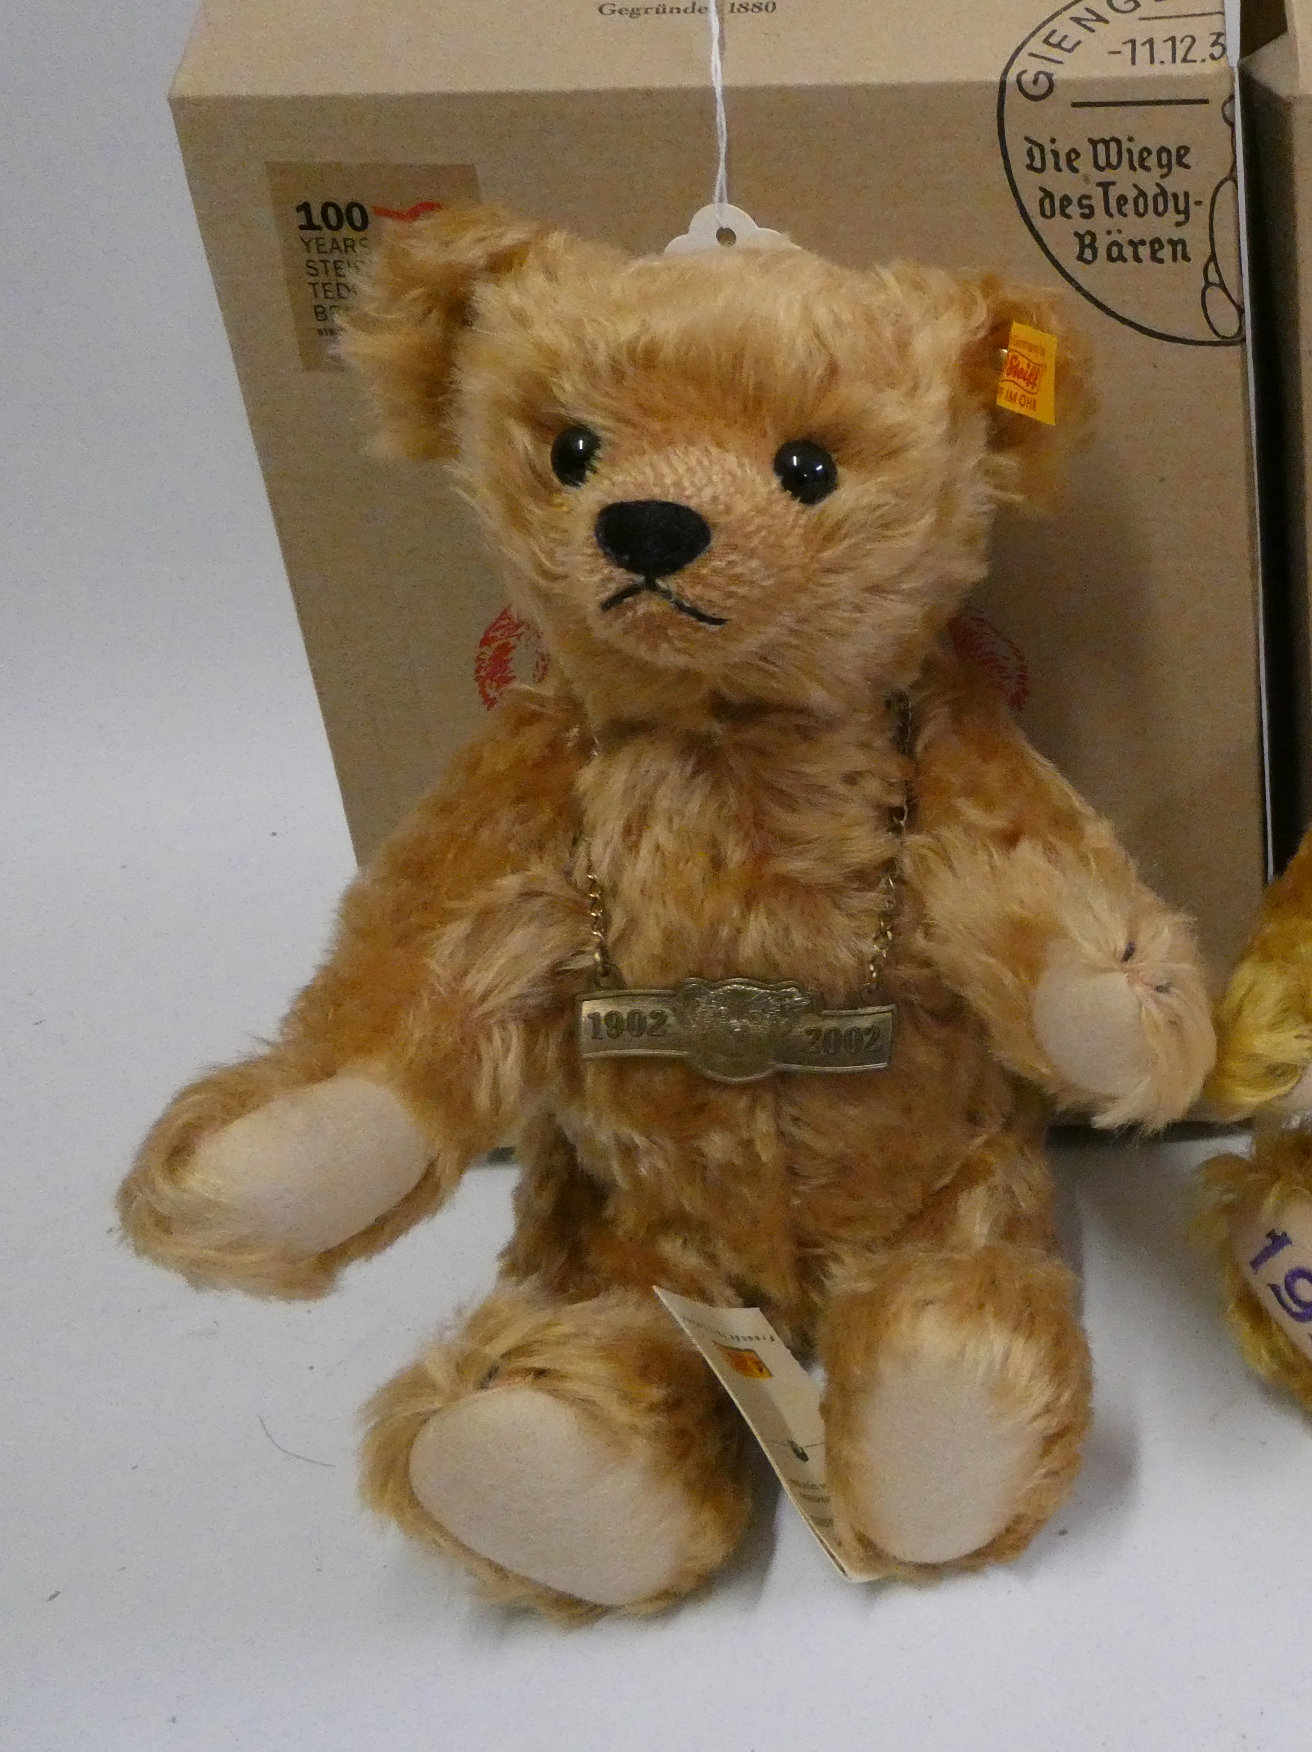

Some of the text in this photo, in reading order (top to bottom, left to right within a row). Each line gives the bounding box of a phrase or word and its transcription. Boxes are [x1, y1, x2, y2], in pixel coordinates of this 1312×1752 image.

[597, 1, 777, 19] Gegründe 1880
[1023, 135, 1192, 179] Die Wiege
[295, 200, 370, 233] 100
[300, 236, 372, 255] YEARS
[1073, 228, 1192, 265] Bären
[307, 281, 358, 301] TED
[587, 1008, 882, 1055] 1902 2002
